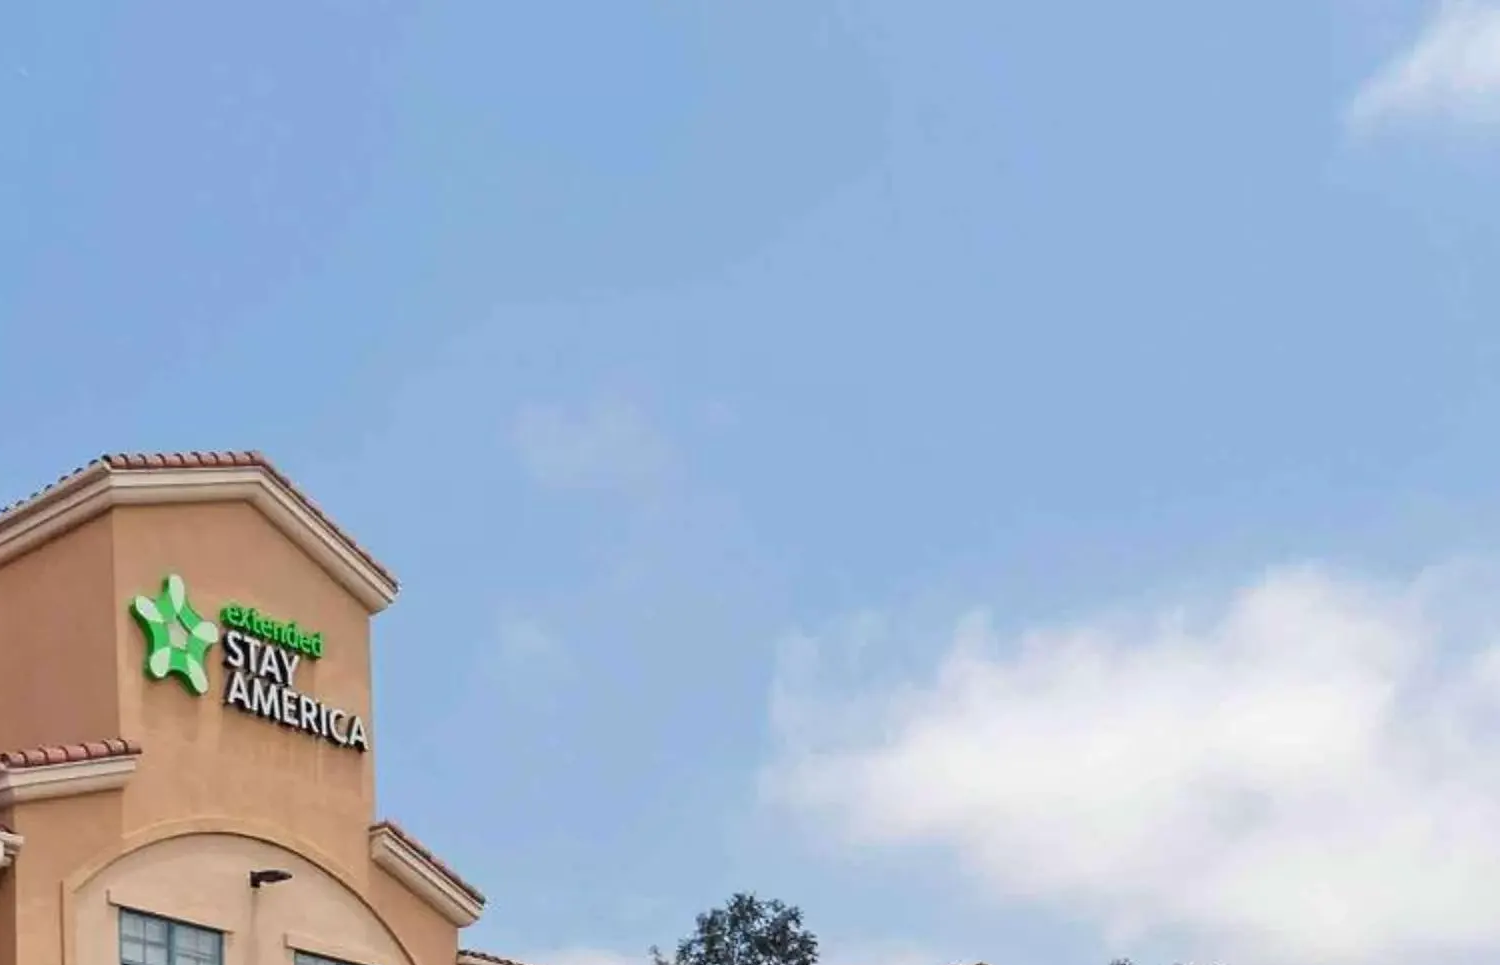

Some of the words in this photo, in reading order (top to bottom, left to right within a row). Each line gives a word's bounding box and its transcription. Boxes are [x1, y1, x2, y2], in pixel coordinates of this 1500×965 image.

[221, 604, 323, 657] extended
[226, 630, 300, 687] STAY
[227, 671, 369, 751] AMERICA
